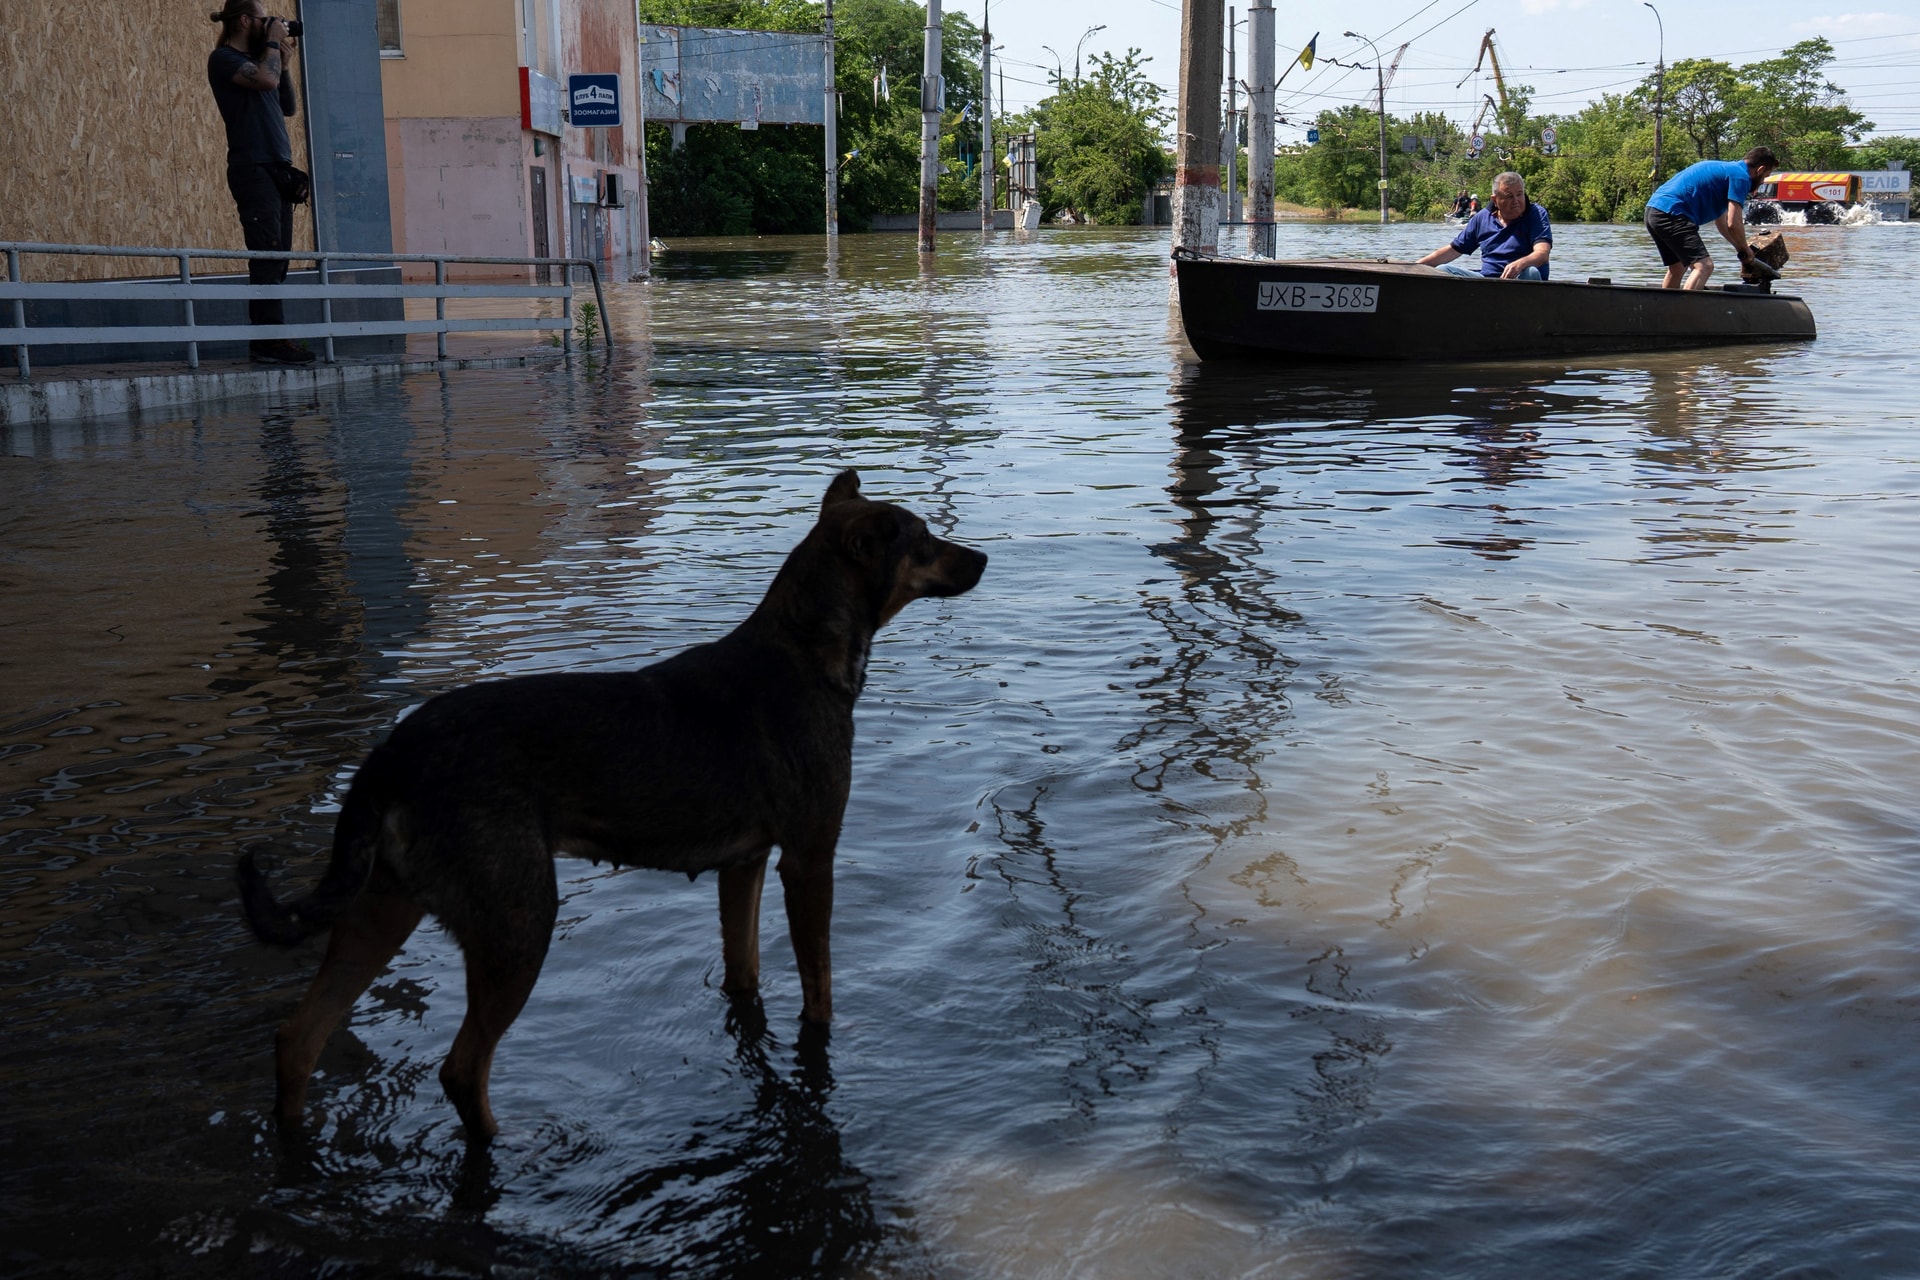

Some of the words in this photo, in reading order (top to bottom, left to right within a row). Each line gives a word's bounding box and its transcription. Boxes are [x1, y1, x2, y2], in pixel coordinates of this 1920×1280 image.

[575, 93, 589, 101] КЛУБ
[590, 86, 597, 99] 4
[1260, 285, 1375, 308] УХВ-3685
